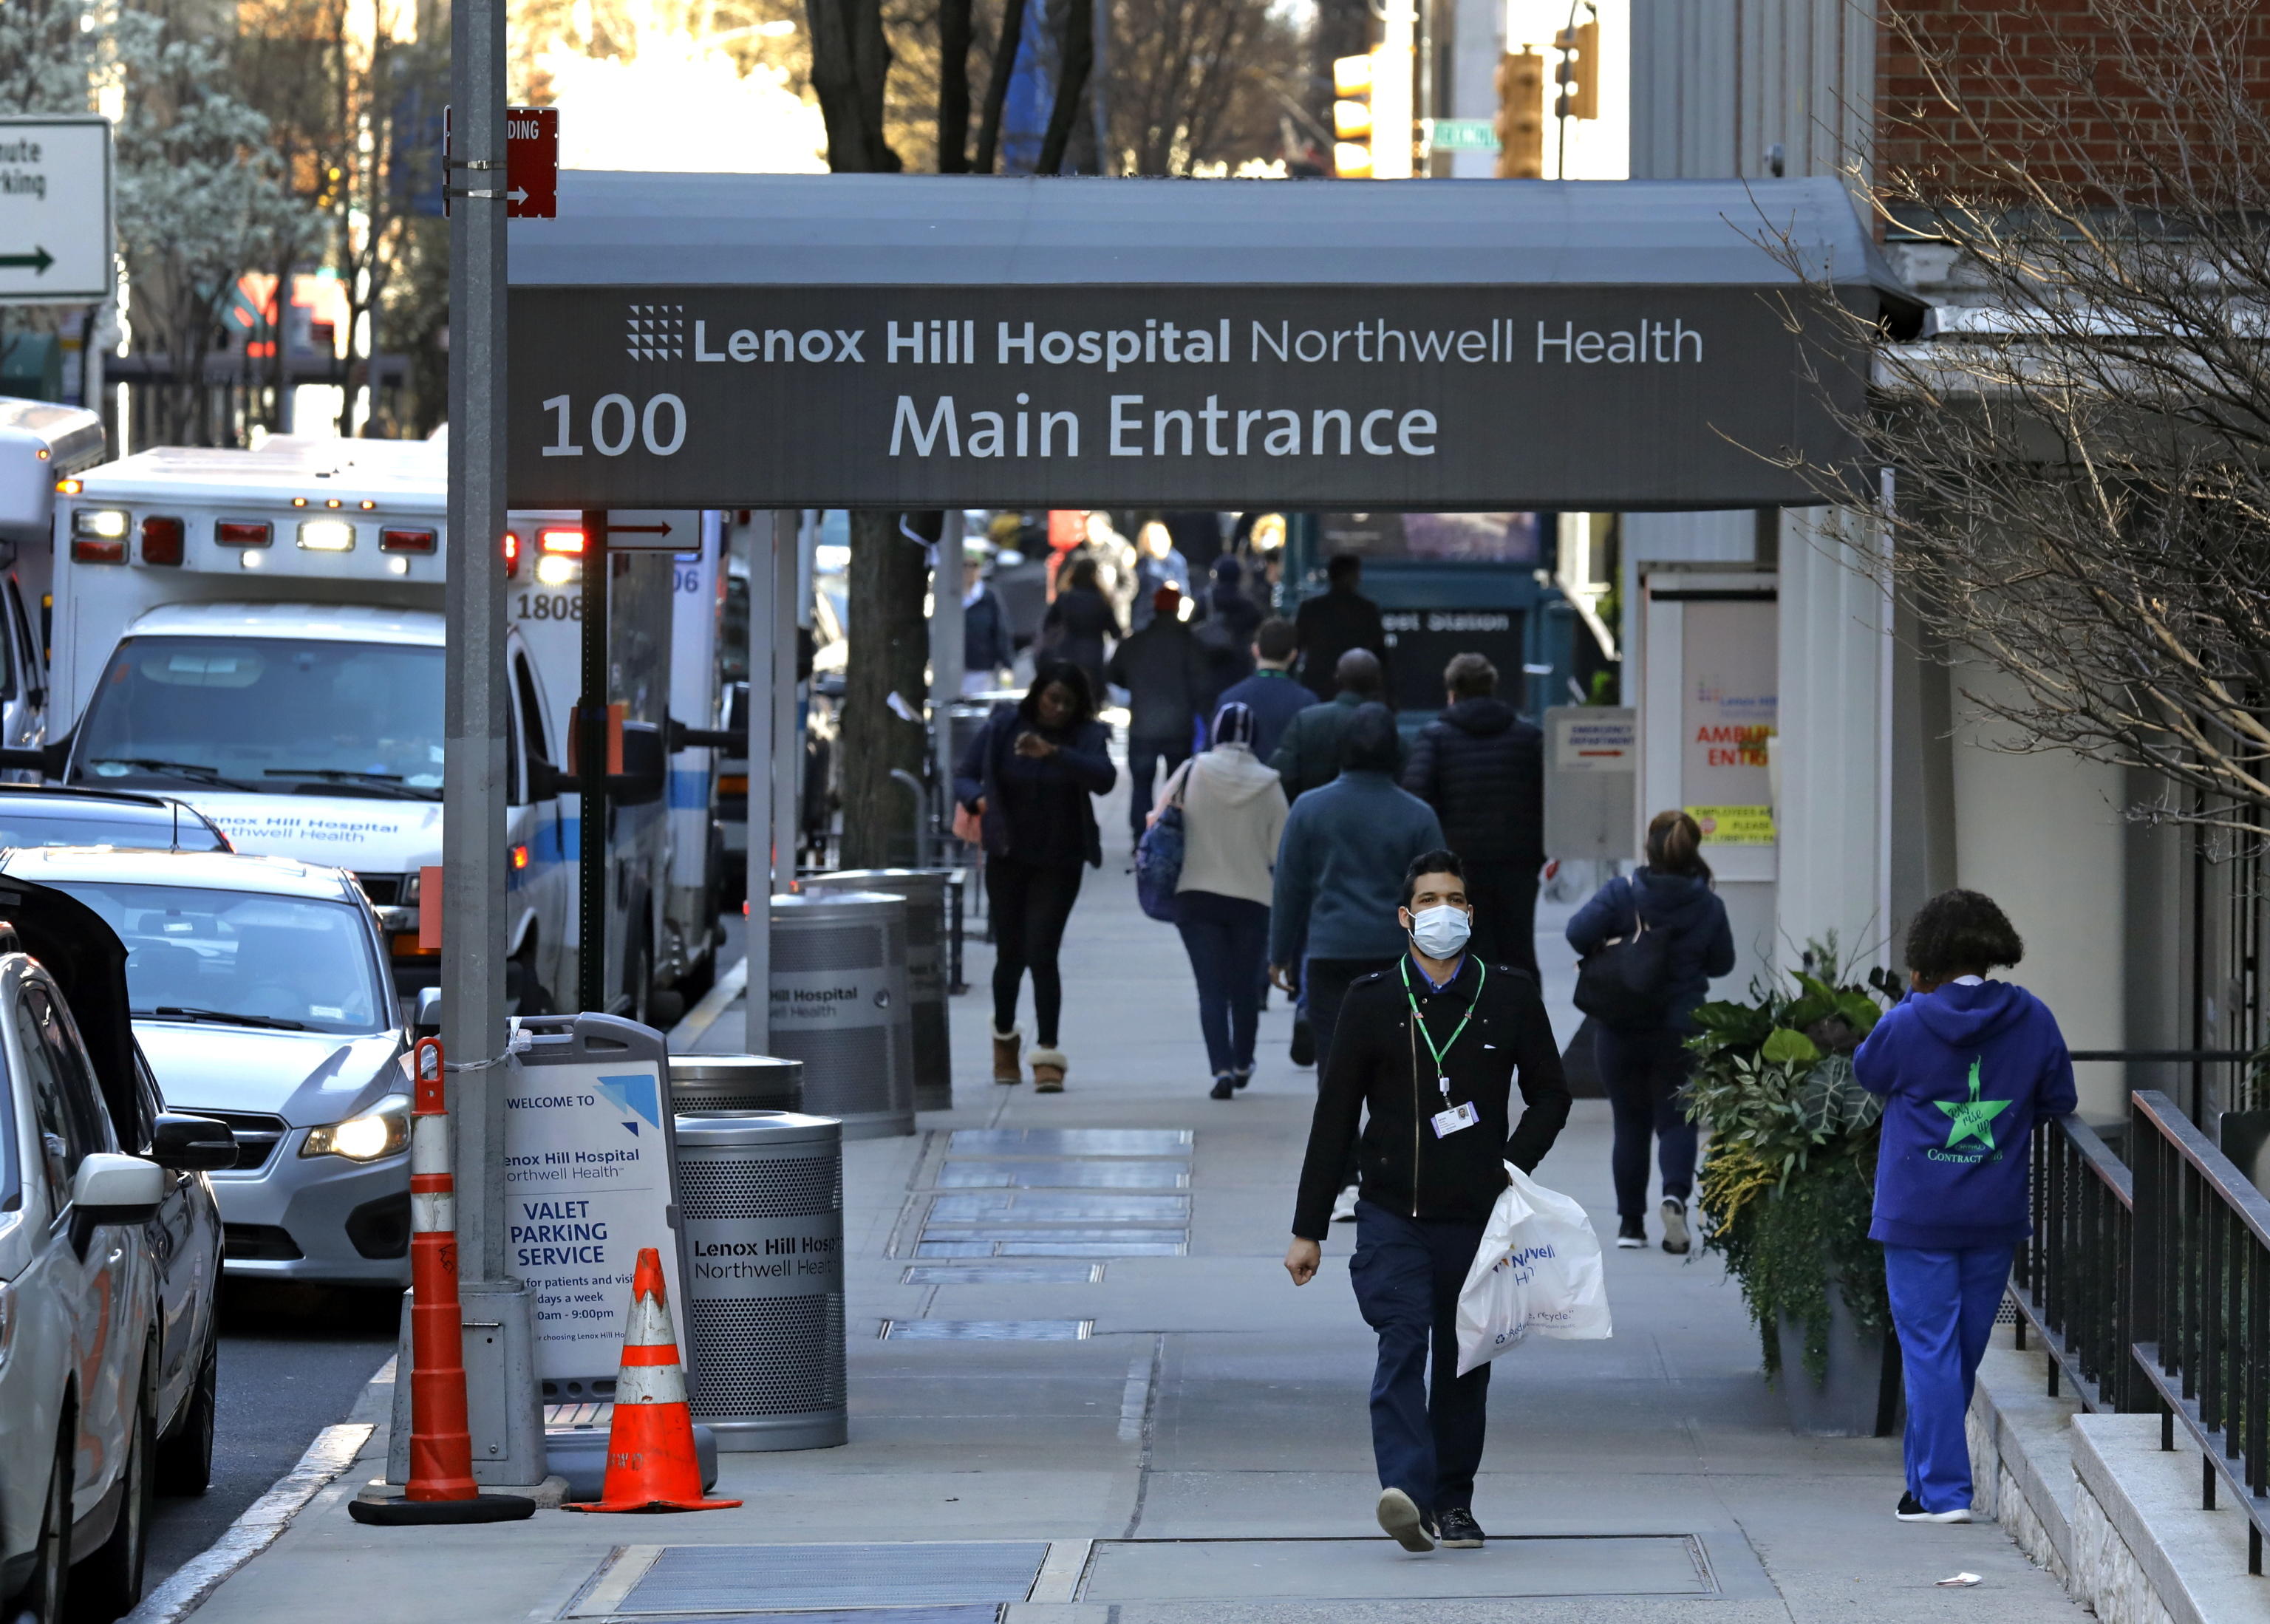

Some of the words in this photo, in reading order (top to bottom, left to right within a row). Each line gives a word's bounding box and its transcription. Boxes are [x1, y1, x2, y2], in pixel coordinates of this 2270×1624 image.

[508, 120, 539, 140] DING
[695, 320, 865, 363] Lenox
[888, 321, 973, 364] Hill
[998, 319, 1230, 372] Hospital
[1252, 319, 1513, 363] Northwell
[1537, 319, 1702, 364] Health
[542, 393, 686, 457] 100
[889, 392, 1079, 457] Main
[1111, 395, 1437, 457] Entrance
[518, 594, 582, 621] 1808
[267, 817, 300, 827] Hill
[309, 819, 398, 833] Hospital
[300, 829, 364, 843] Health
[794, 986, 857, 1003] Hospital
[507, 1096, 573, 1109] WELCOME
[576, 1095, 595, 1106] TO
[1963, 1110, 1983, 1126] rise
[1977, 1119, 1989, 1134] up
[545, 1152, 570, 1164] Hill
[575, 1148, 639, 1164] Hospital
[523, 1201, 590, 1220] VALET
[511, 1223, 607, 1243] PARKING
[695, 1241, 758, 1256] Lenox
[766, 1237, 796, 1255] Hill
[517, 1246, 604, 1266] SERVICE
[695, 1259, 791, 1279] Northwell
[526, 1277, 541, 1288] for
[545, 1277, 589, 1289] patients
[592, 1275, 612, 1285] and
[537, 1294, 562, 1306] days
[573, 1292, 604, 1302] week
[572, 1309, 614, 1320] 9:00pm
[543, 1333, 576, 1342] choosing
[600, 1331, 613, 1339] Hill
